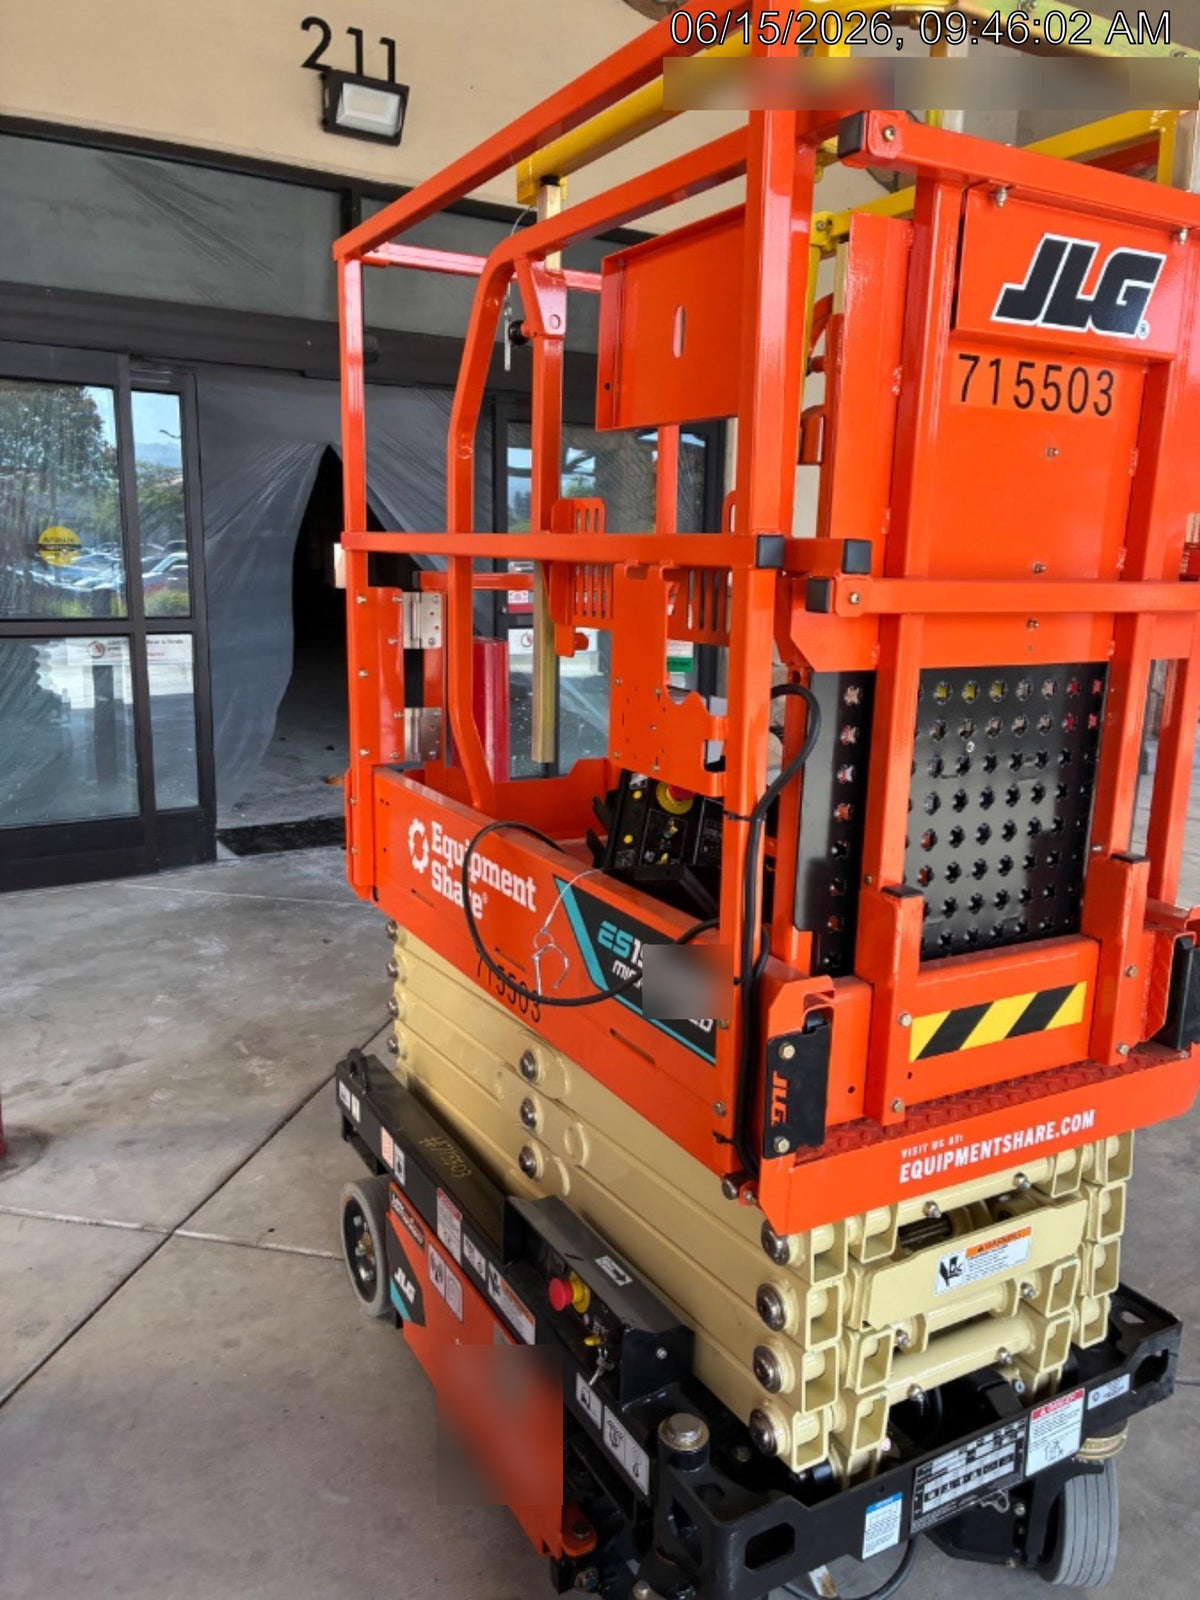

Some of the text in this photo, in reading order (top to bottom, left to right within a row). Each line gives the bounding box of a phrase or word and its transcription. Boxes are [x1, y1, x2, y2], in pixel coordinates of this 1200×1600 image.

[301, 16, 395, 84] 211
[990, 233, 1167, 338] JLG
[958, 353, 1114, 417] 715503
[431, 859, 484, 920] Shae
[771, 1070, 789, 1127] JLG
[899, 1109, 1096, 1184] EQUIPMENTSHARE.COM
[901, 1142, 929, 1159] VISIT
[932, 1138, 945, 1151] US
[394, 1266, 416, 1304] JLG
